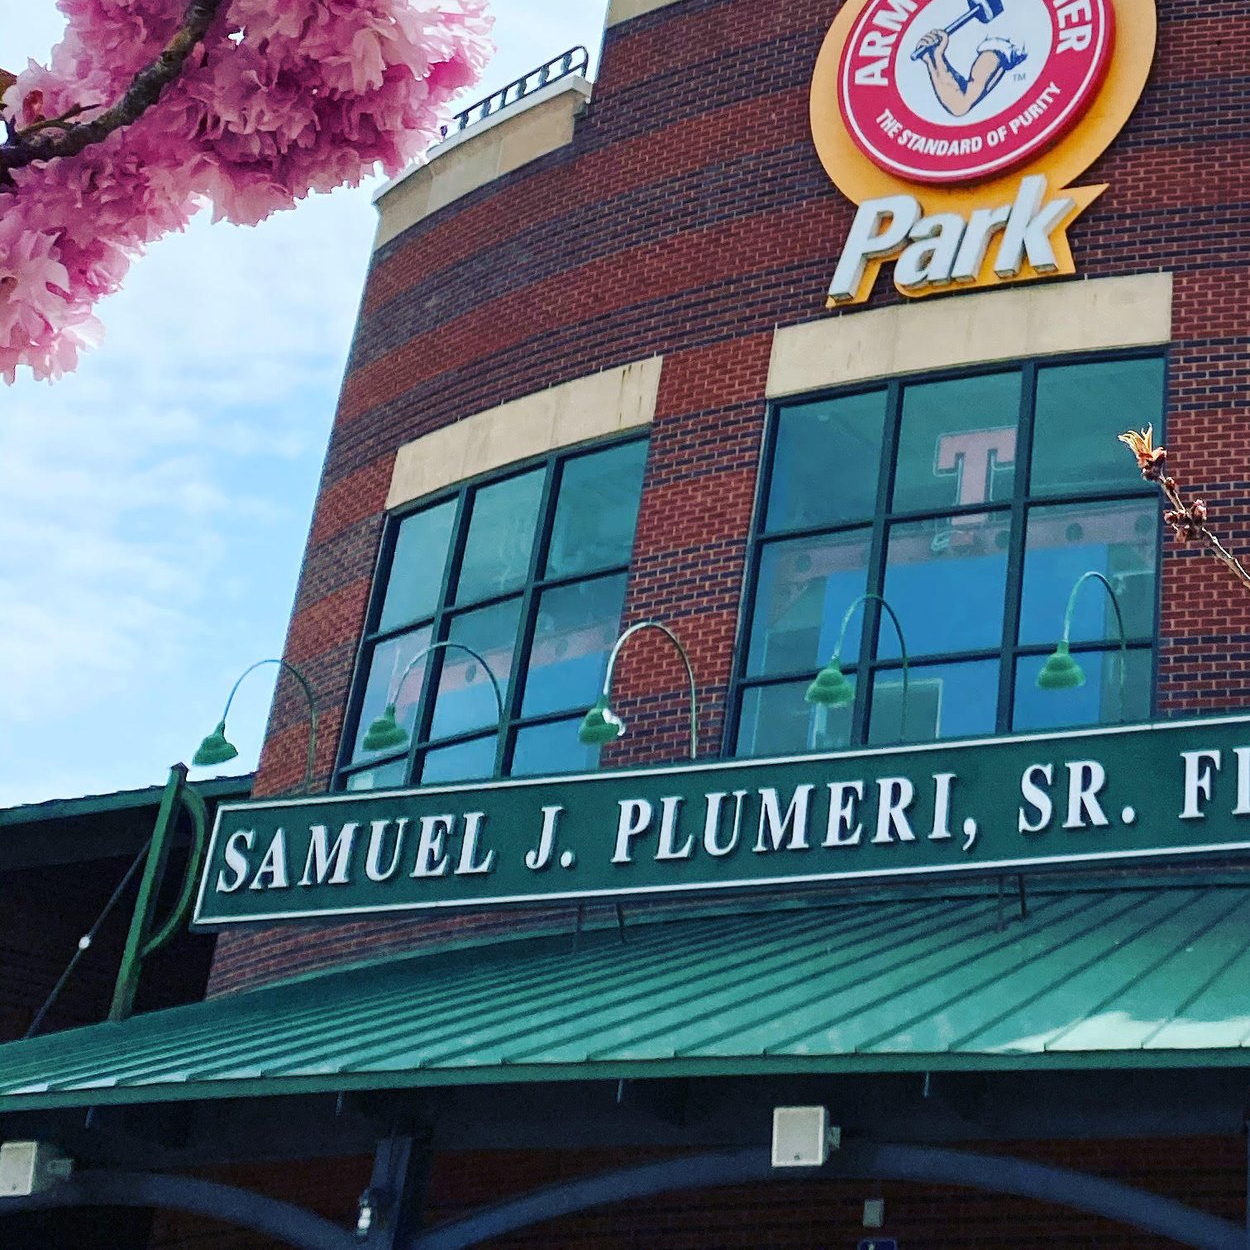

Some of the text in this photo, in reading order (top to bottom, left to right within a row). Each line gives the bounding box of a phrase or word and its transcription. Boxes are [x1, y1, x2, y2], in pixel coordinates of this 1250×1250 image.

[875, 81, 1062, 156] THE STANDARD OF PURITY
[1012, 73, 1027, 82] TM
[827, 174, 1077, 302] Park
[215, 810, 496, 894] SAMUEL
[524, 805, 576, 870] J.
[610, 772, 979, 864] PLUMERI,
[1018, 759, 1136, 835] SR.
